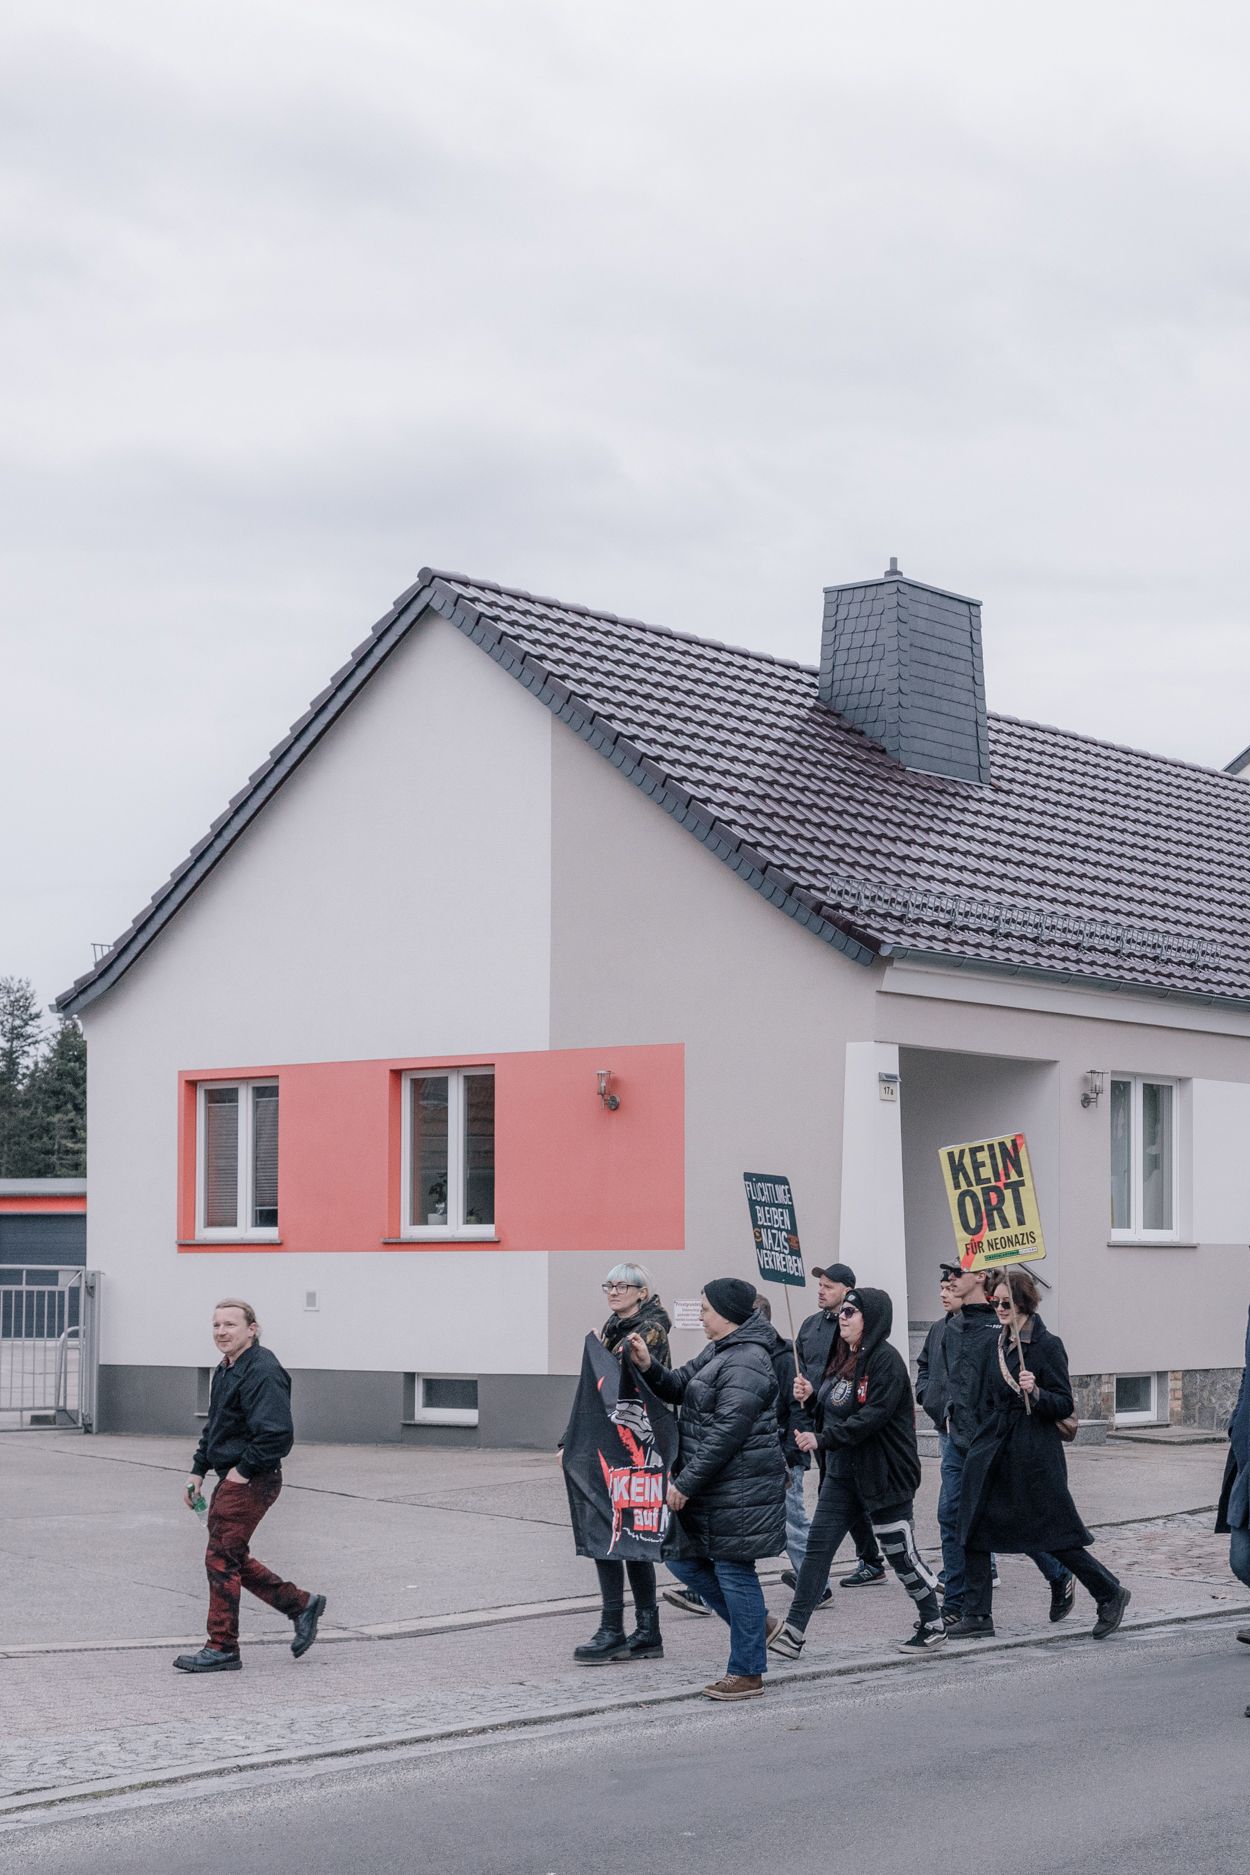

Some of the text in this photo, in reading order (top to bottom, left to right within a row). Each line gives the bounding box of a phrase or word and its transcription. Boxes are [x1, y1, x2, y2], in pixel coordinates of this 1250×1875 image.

[946, 1138, 1024, 1190] KEIN
[755, 1205, 791, 1230] BLEIBEN
[957, 1179, 1026, 1236] ORT
[761, 1227, 790, 1254] NAZIS
[965, 1237, 985, 1256] FÜR
[986, 1231, 1037, 1250] NEONAZIS
[757, 1249, 805, 1277] VERTREIBEN
[613, 1474, 663, 1502] KEIN
[633, 1508, 659, 1528] auf
